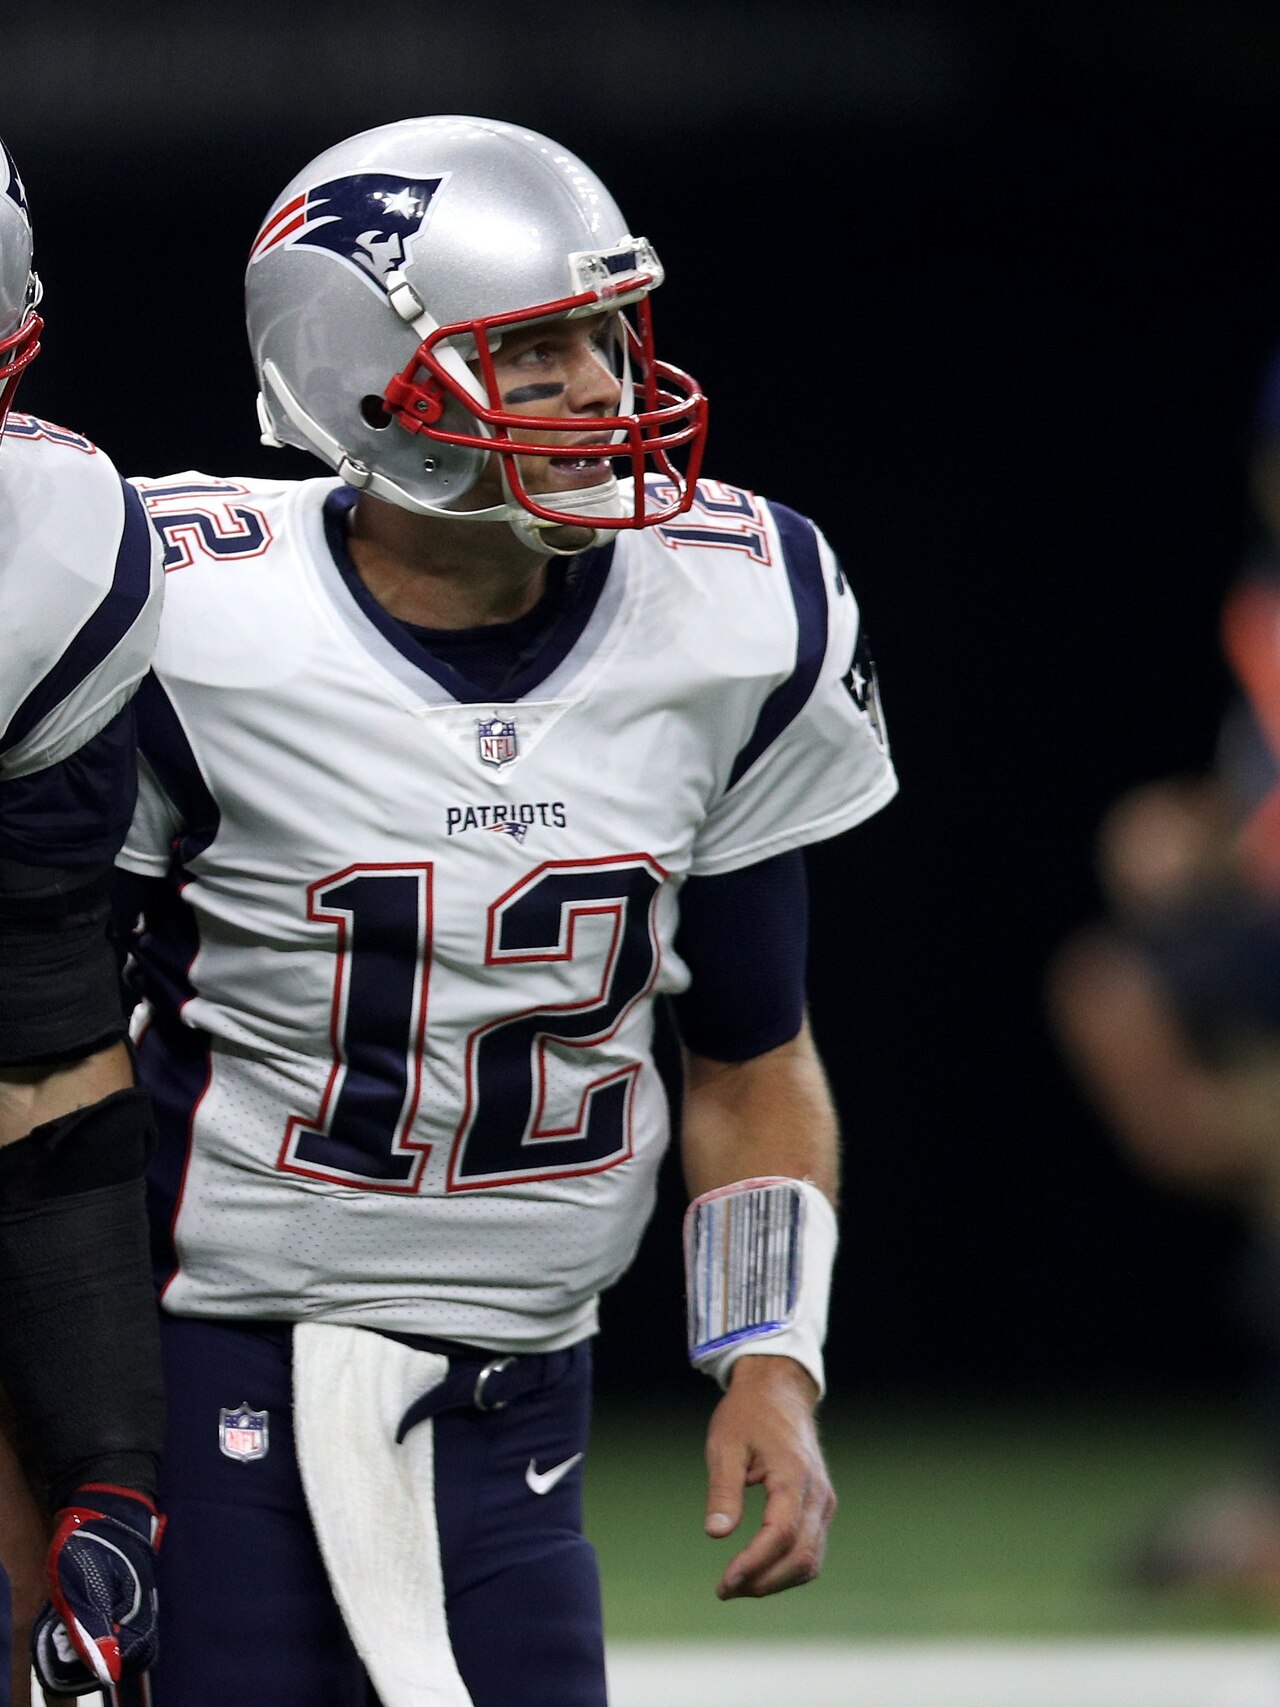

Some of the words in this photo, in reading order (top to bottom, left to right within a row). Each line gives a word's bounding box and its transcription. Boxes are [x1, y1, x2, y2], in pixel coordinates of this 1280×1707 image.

[136, 480, 274, 574] 12
[644, 480, 772, 567] 12
[483, 738, 513, 760] NFL
[446, 802, 566, 835] PATRIOTS
[277, 852, 669, 1194] 12
